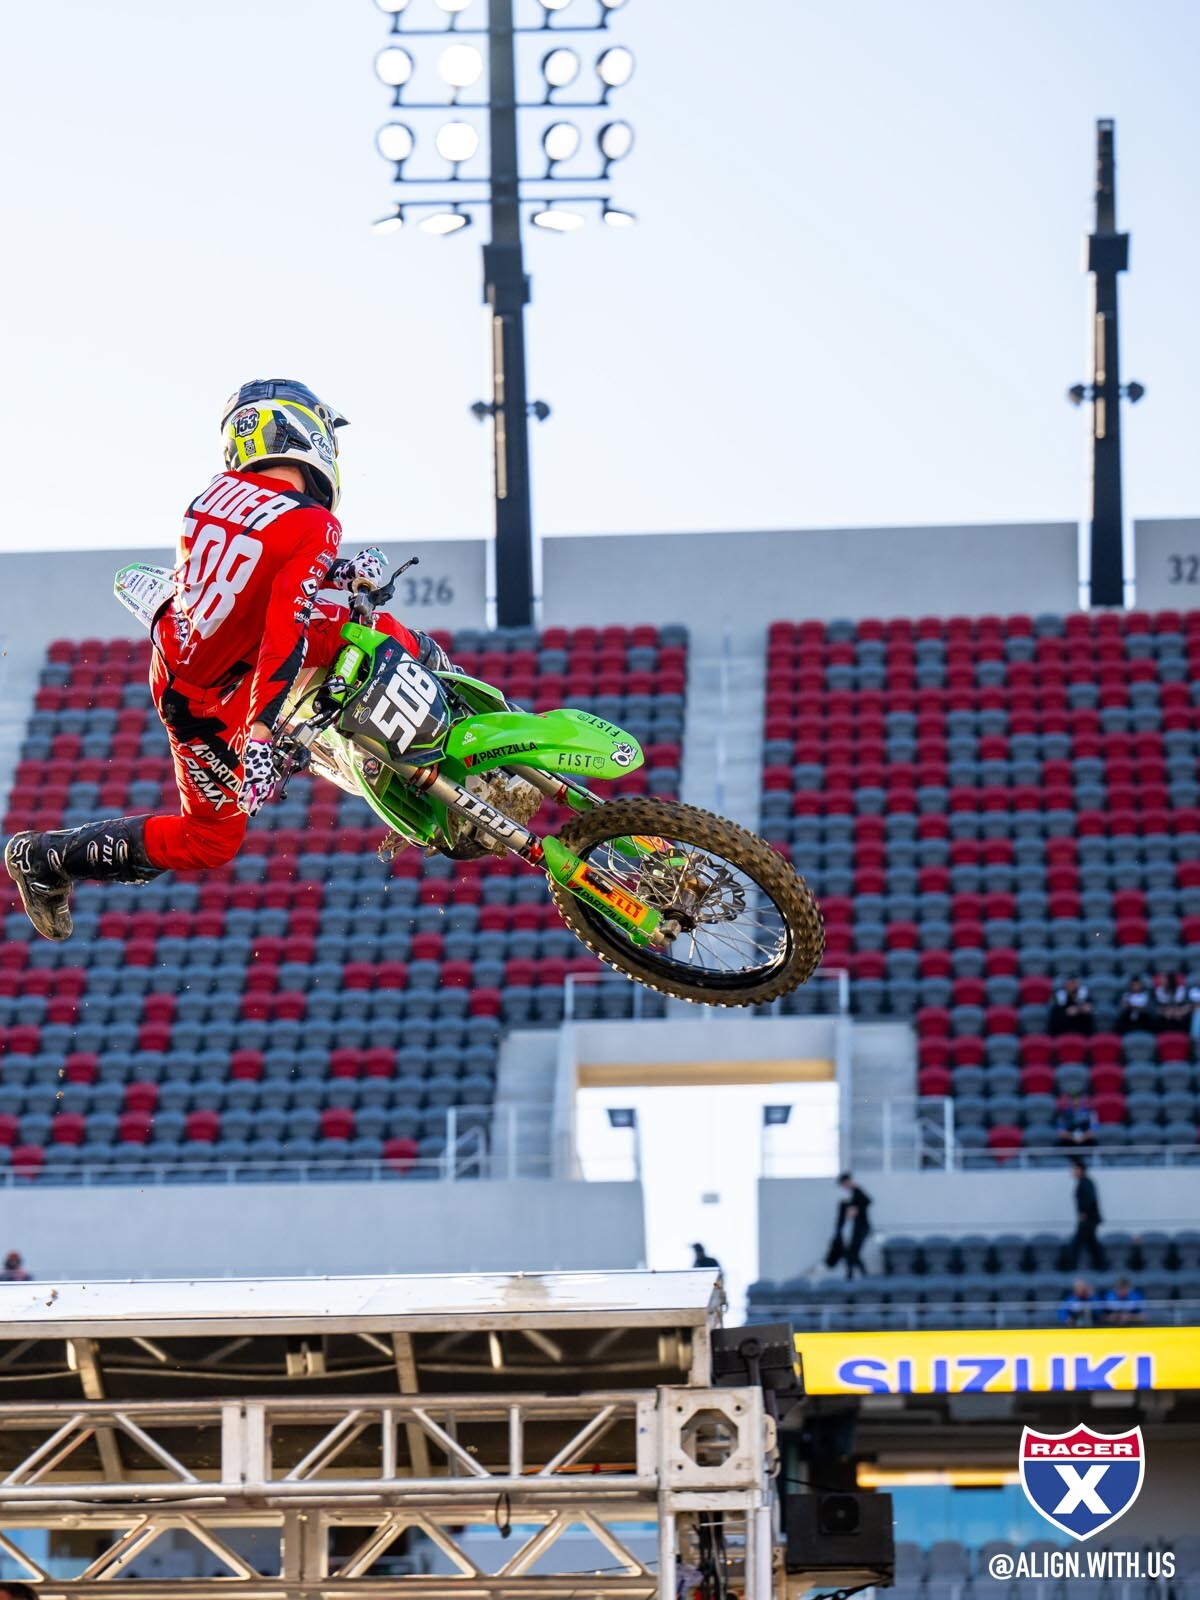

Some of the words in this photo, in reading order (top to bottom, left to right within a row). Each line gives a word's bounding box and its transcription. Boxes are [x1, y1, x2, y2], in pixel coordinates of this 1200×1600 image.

[235, 413, 258, 434] 153
[193, 474, 300, 531] ODER
[403, 576, 454, 607] 326
[369, 652, 438, 755] 508
[588, 717, 621, 738] FIST
[479, 741, 538, 762] PARTZILLA
[558, 752, 592, 768] FIST
[182, 757, 234, 811] PRMX
[102, 834, 114, 866] FOX
[579, 889, 630, 930] PARTZILLA
[838, 1357, 1152, 1394] SUZUKI
